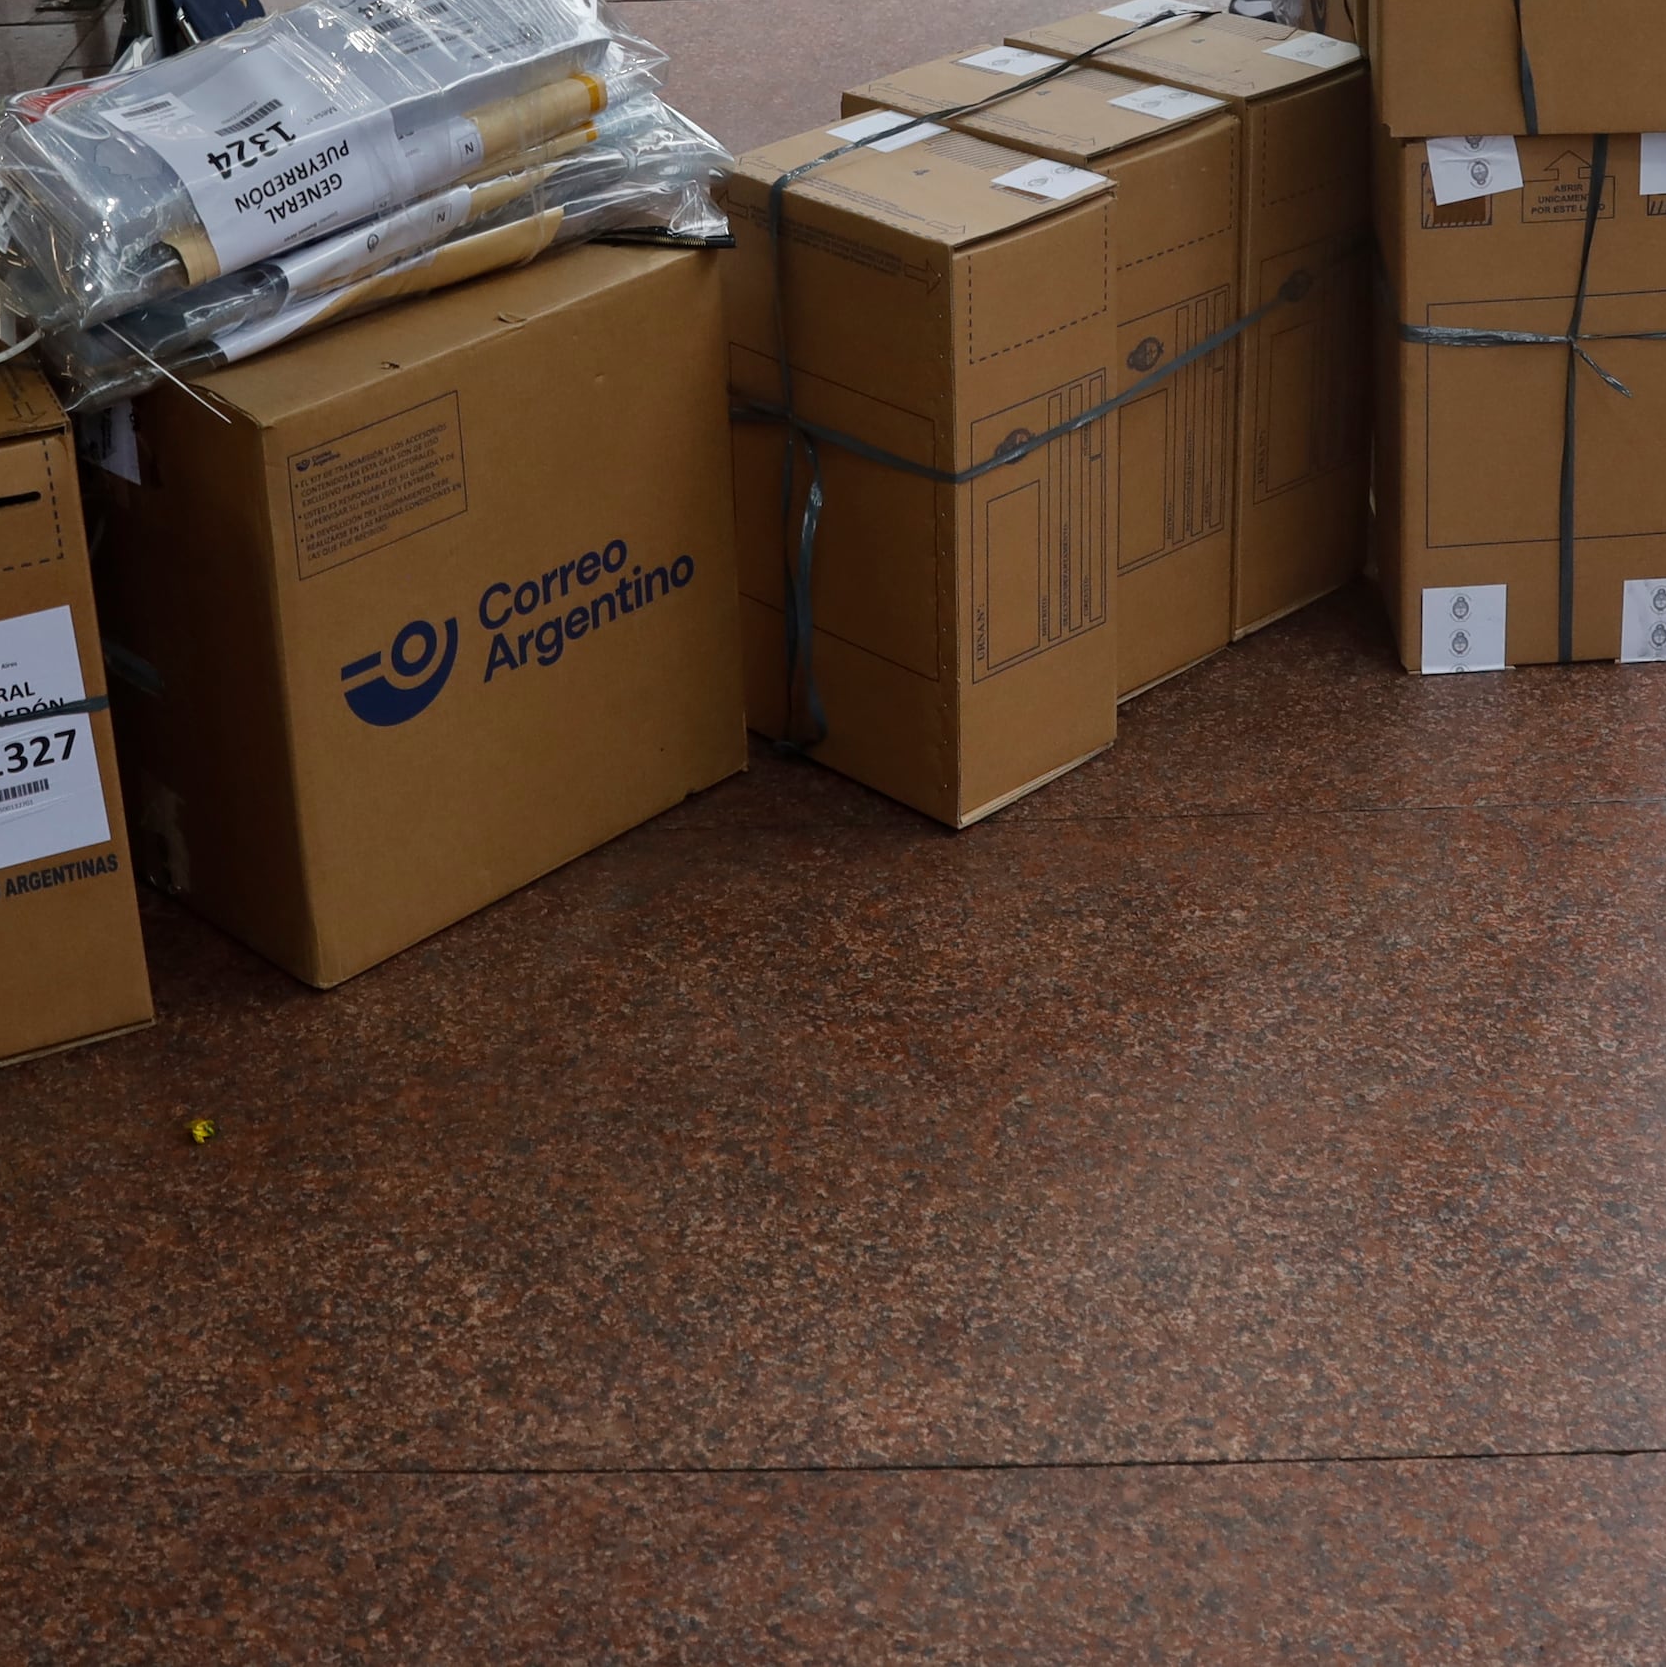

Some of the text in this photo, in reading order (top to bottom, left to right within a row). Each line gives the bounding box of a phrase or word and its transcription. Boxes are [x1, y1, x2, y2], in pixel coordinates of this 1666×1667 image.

[464, 141, 475, 155] N
[234, 139, 350, 213] PUEYRREDÓN
[264, 173, 342, 225] GENERAL
[1553, 183, 1584, 194] ABRIR
[1531, 205, 1551, 215] POR
[1553, 204, 1578, 214] ESTE
[479, 539, 628, 631] Correo
[483, 555, 695, 684] Argentino
[5, 854, 118, 898] ARGENTINAS
